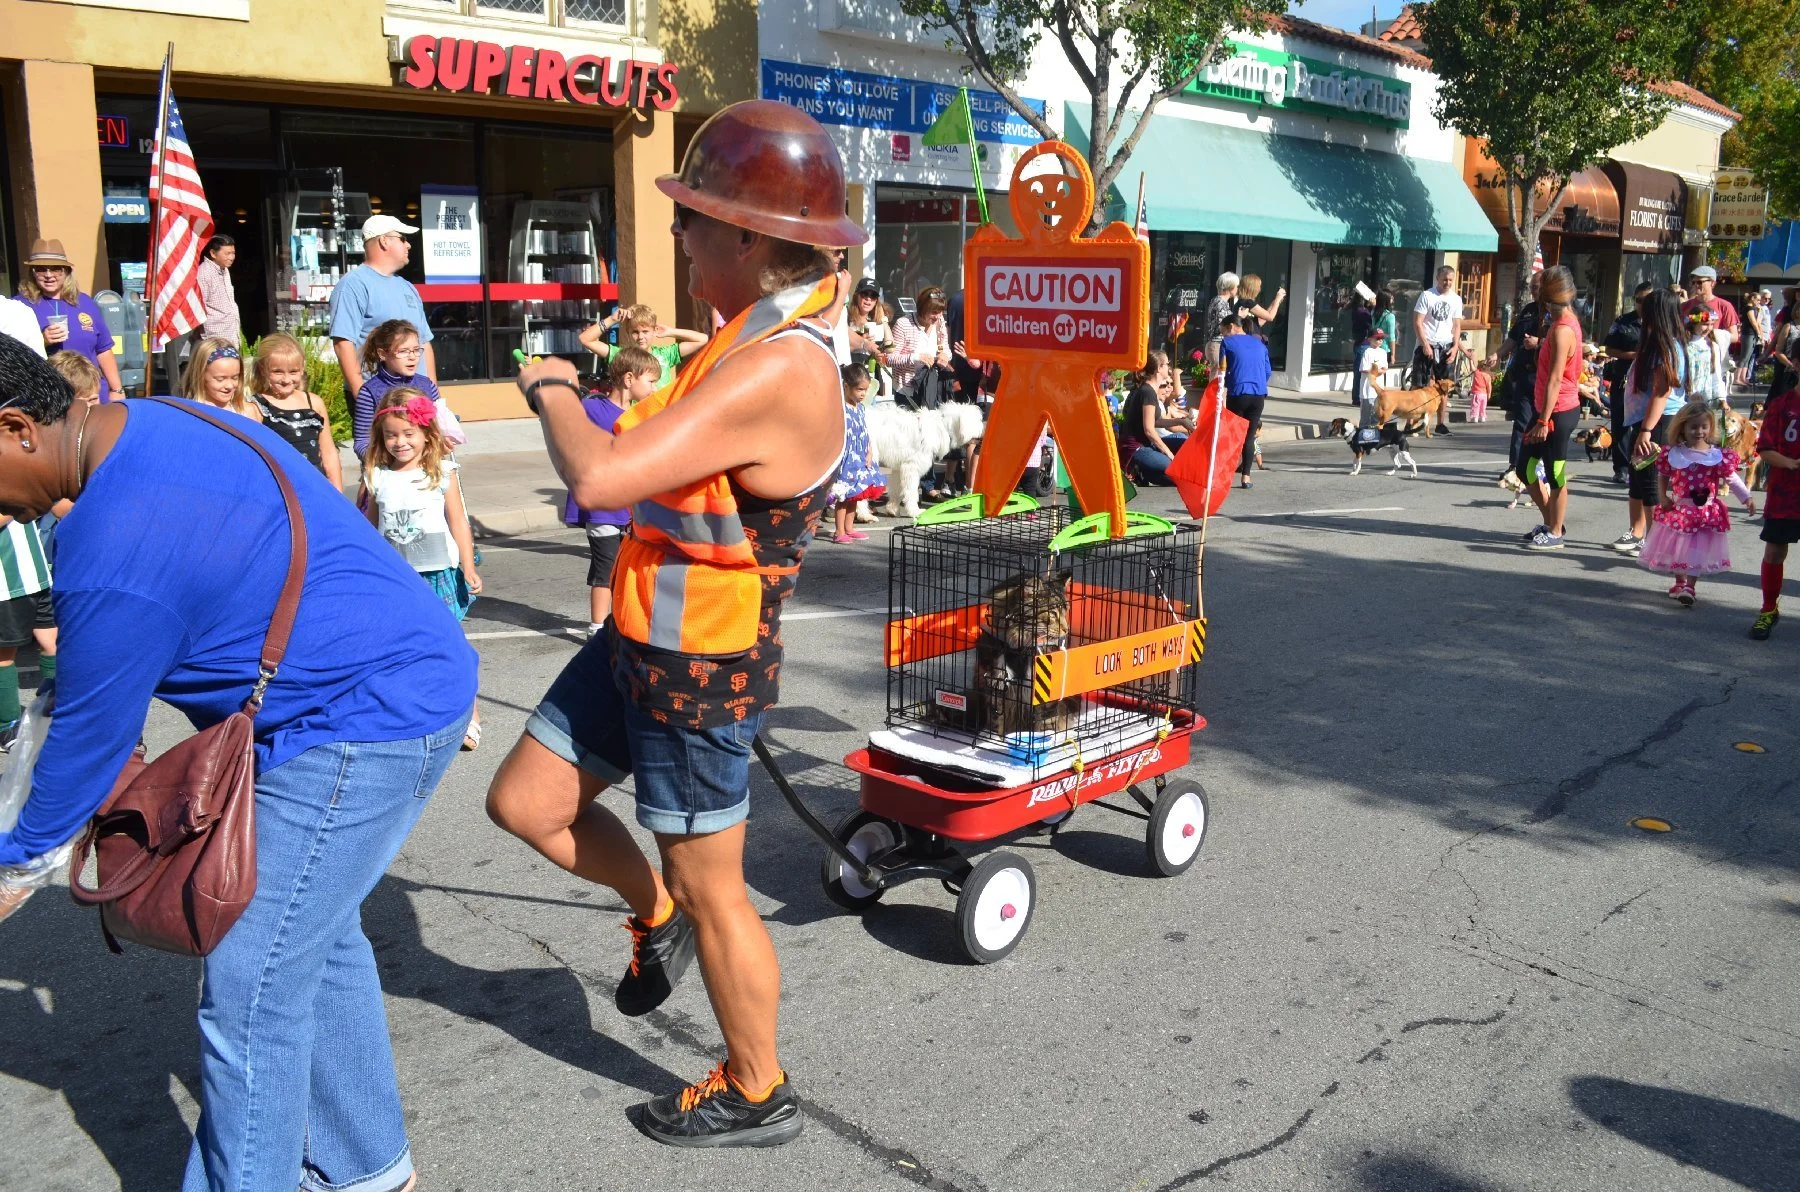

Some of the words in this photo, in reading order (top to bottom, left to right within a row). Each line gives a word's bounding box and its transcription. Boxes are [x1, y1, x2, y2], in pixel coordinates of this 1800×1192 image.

[403, 34, 679, 111] SUPERCUTS
[775, 71, 831, 93] PHONES
[835, 79, 862, 95] YOU
[866, 83, 899, 101] LOVE
[827, 100, 854, 117] YOU
[857, 104, 895, 122] WANT
[990, 121, 1041, 139] SERVICES
[928, 145, 959, 154] NOKIA
[1713, 192, 1736, 203] Grace
[1737, 192, 1766, 203] Garden
[105, 203, 145, 216] OPEN
[445, 206, 458, 215] THE
[436, 214, 466, 224] PERFECT
[440, 222, 464, 231] FINISH
[1630, 210, 1658, 228] FLORIST
[1658, 213, 1663, 229] &
[433, 241, 447, 249] HOT
[449, 241, 471, 249] TOWEL
[433, 249, 472, 257] REFRESHER
[990, 272, 1115, 304] CAUTION
[985, 313, 1050, 336] Children
[1055, 318, 1073, 336] at
[1079, 318, 1118, 345] Play
[1784, 419, 1797, 442] 6
[1095, 650, 1122, 675] LOOK
[1132, 642, 1157, 667] BOTH
[1162, 635, 1185, 658] WAYS
